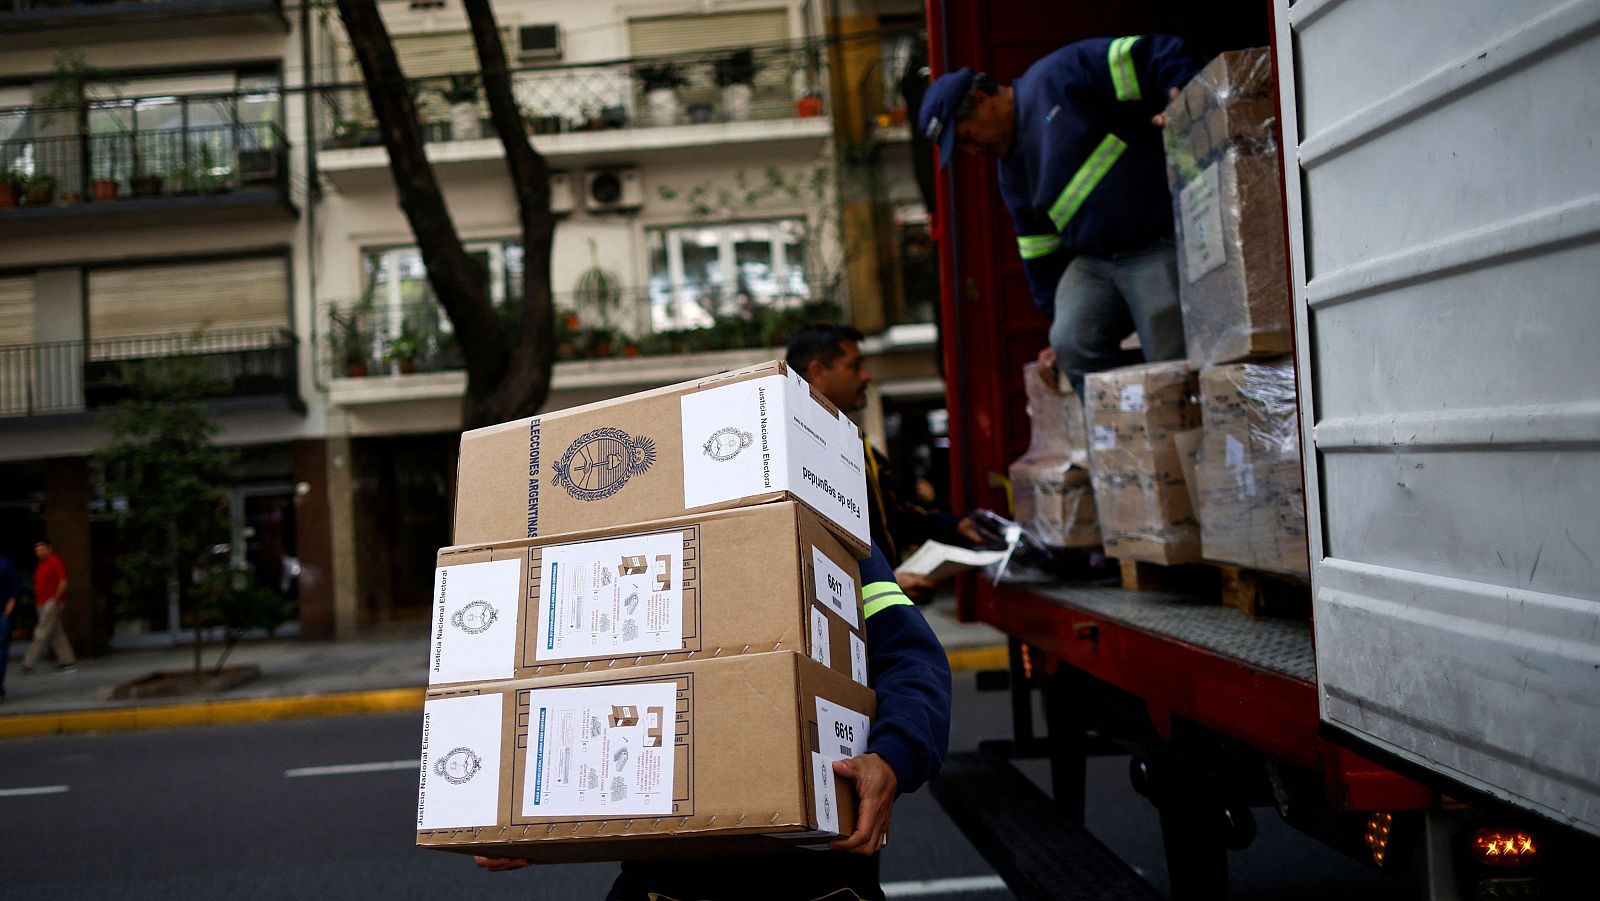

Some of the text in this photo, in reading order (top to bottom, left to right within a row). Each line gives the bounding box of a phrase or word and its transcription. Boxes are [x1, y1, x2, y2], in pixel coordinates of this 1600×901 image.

[527, 418, 541, 538] ELECCIONES ARGENTINAS
[759, 386, 772, 488] Justicia Nacional Electoral
[802, 466, 861, 519] Faja de seguridad
[433, 570, 448, 673] Justicia Nacional Electoral
[828, 573, 843, 597] 6617
[418, 712, 431, 826] Justicia Nacional Electoral
[834, 720, 854, 743] 6615
